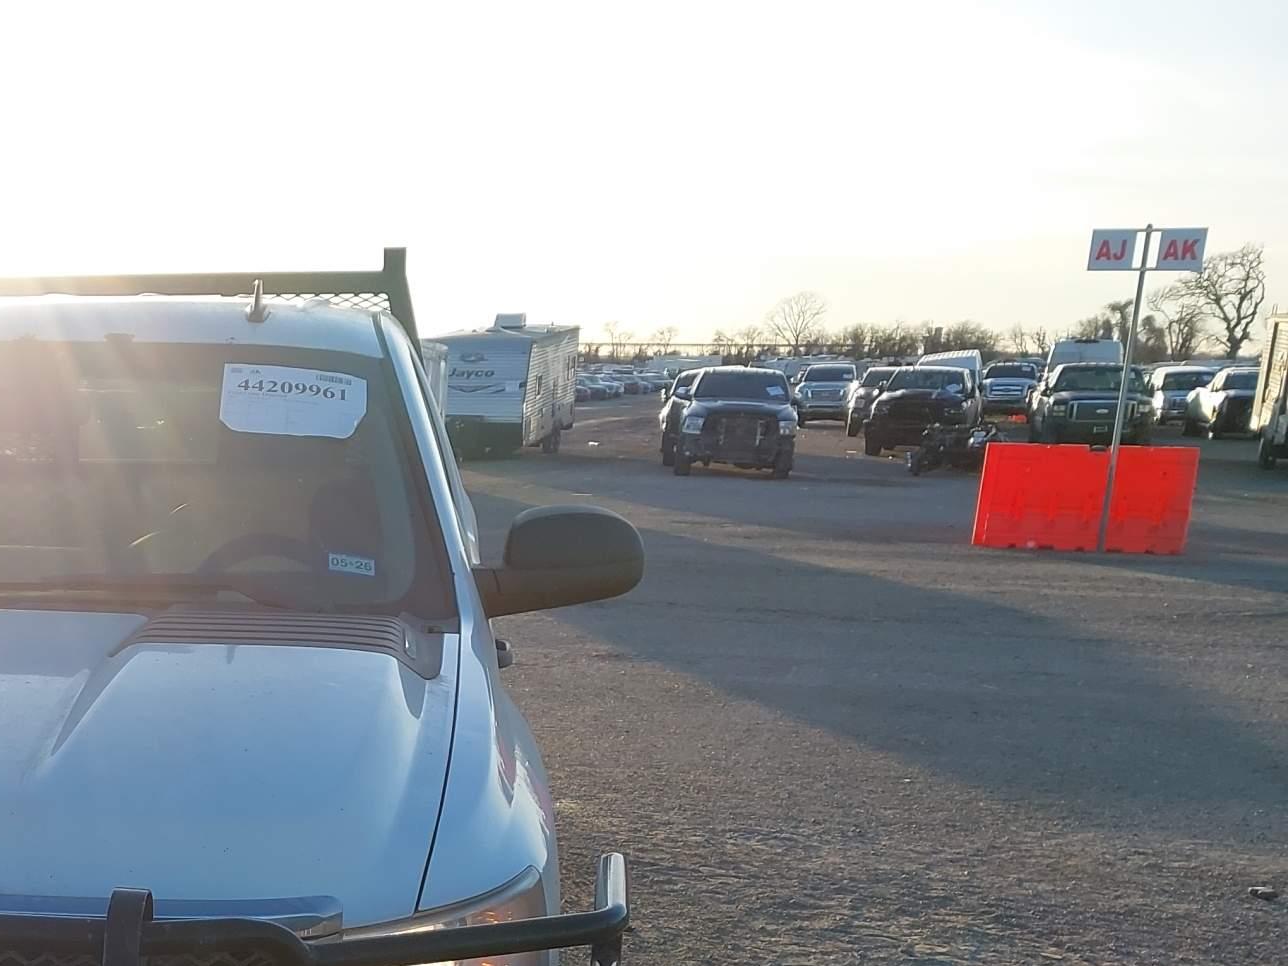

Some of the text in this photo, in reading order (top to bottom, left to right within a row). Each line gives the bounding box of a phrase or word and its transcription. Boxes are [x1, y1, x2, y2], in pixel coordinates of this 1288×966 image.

[1095, 239, 1128, 261] AJ
[1162, 238, 1201, 261] AK
[449, 367, 495, 380] Jayco
[237, 378, 346, 401] 44209961
